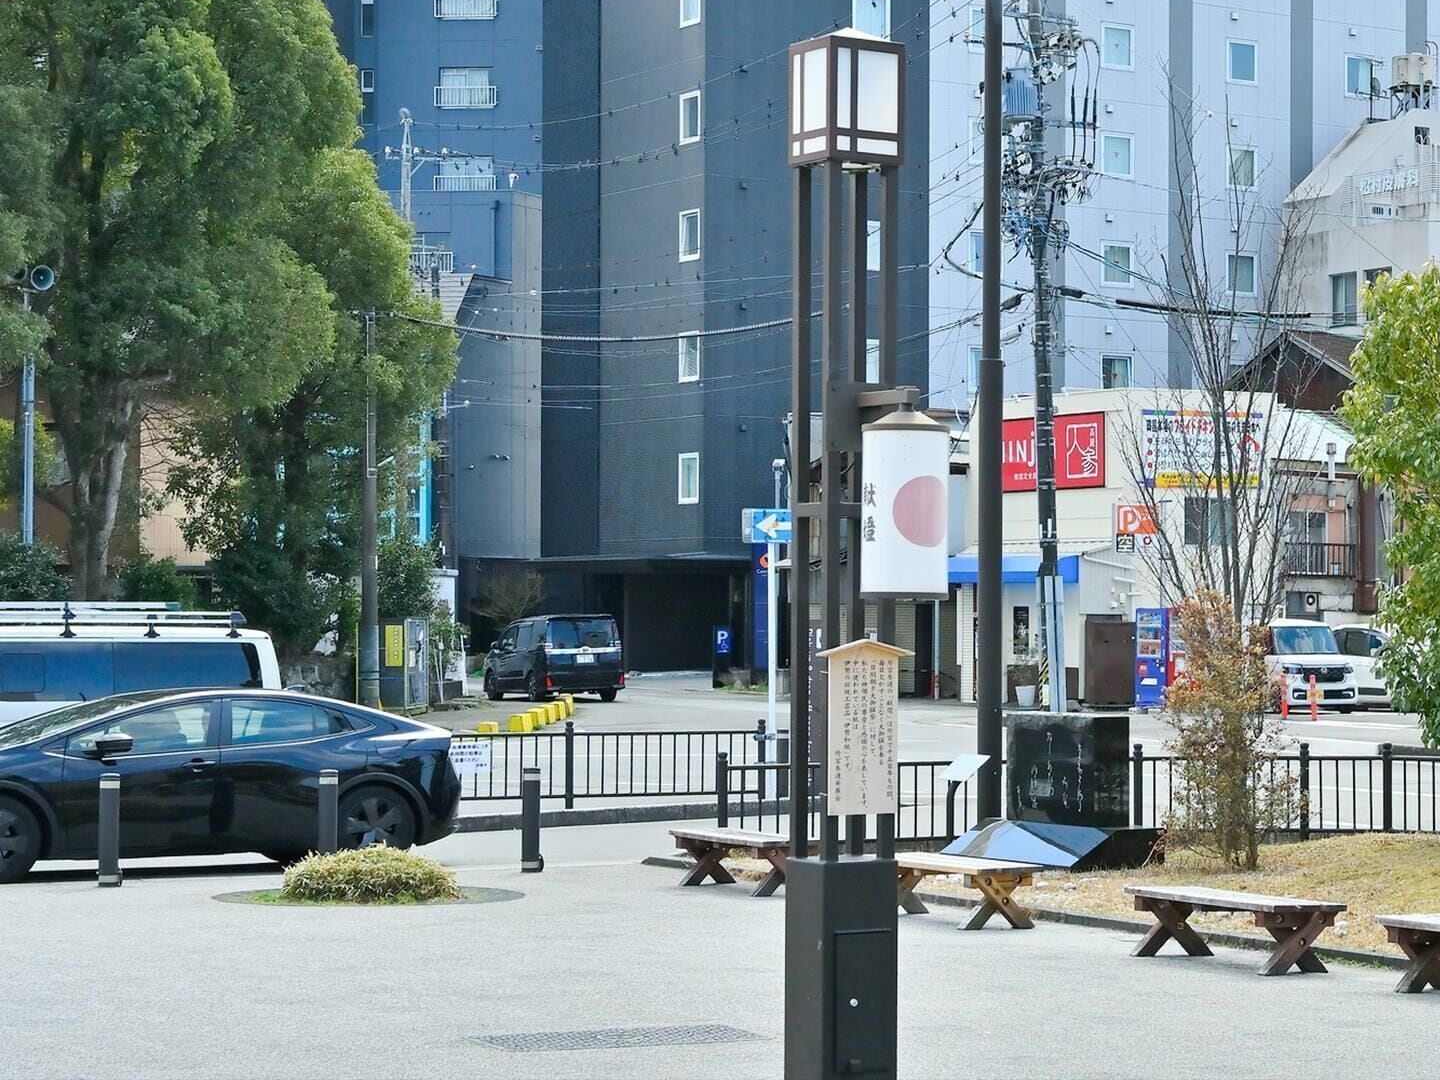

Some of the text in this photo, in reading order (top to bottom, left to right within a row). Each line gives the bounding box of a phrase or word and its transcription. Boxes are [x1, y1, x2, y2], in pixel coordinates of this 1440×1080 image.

[1359, 168, 1419, 195] 松村皮膚科
[1119, 506, 1142, 532] P
[1117, 534, 1134, 552] 空
[717, 630, 729, 645] P
